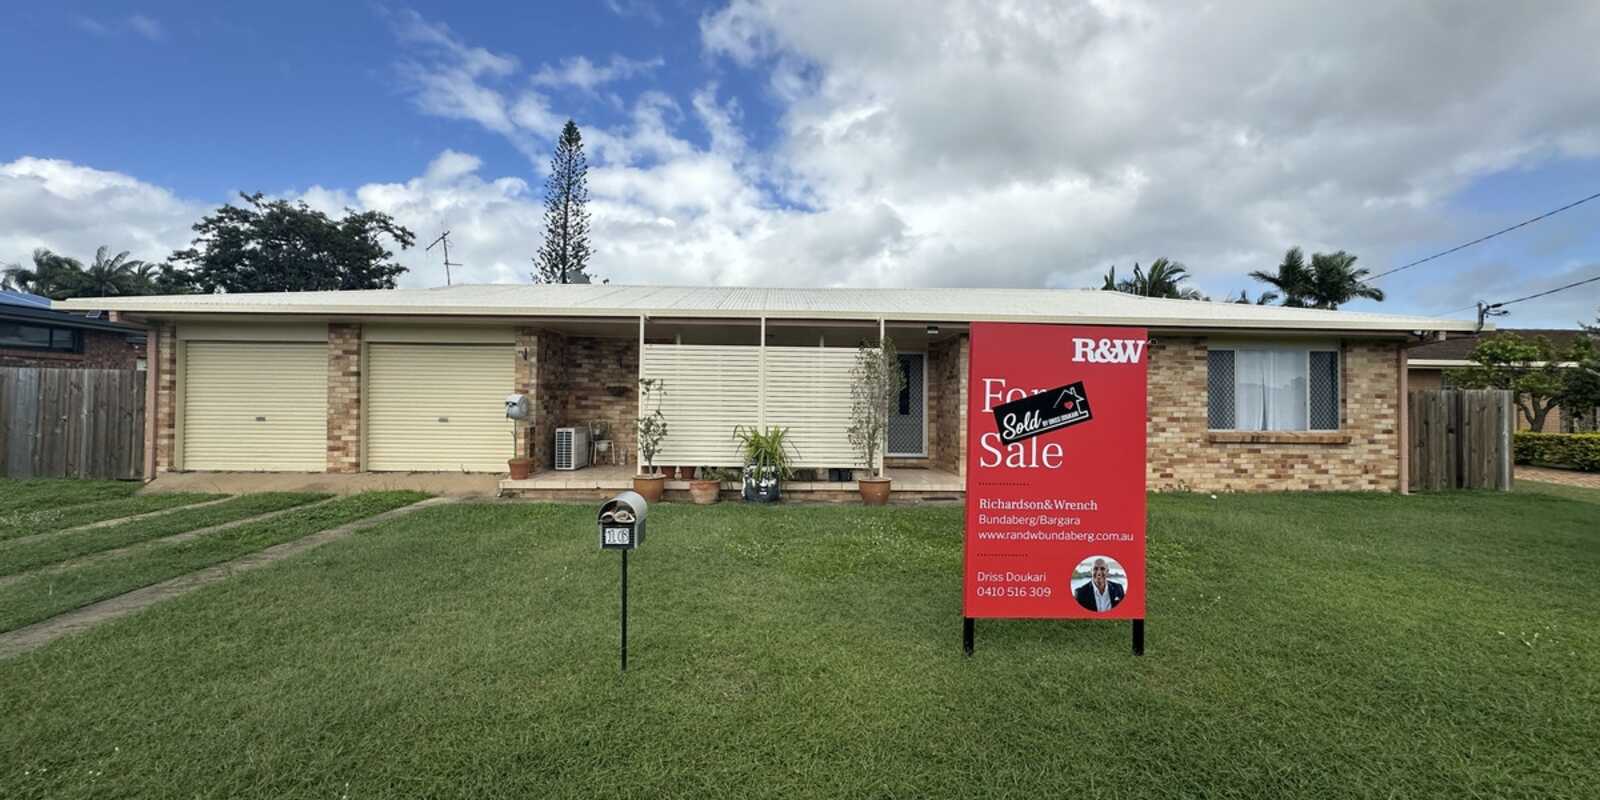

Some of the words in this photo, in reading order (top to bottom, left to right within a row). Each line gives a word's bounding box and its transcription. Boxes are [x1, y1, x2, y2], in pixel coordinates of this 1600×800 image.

[1071, 338, 1145, 363] R&W
[981, 377, 1047, 413] Fo
[1002, 409, 1041, 440] Sold
[980, 432, 1063, 469] Sale
[979, 498, 1098, 511] Richardson&Wrench
[978, 514, 1081, 527] Bundaberg/Bargara
[978, 530, 1134, 543] www.randwbundaberg.com.au
[977, 571, 1004, 582] Driss
[1006, 571, 1047, 582] Doukari
[976, 586, 1005, 597] 0410
[1007, 586, 1027, 597] 516
[1028, 586, 1052, 598] 309
